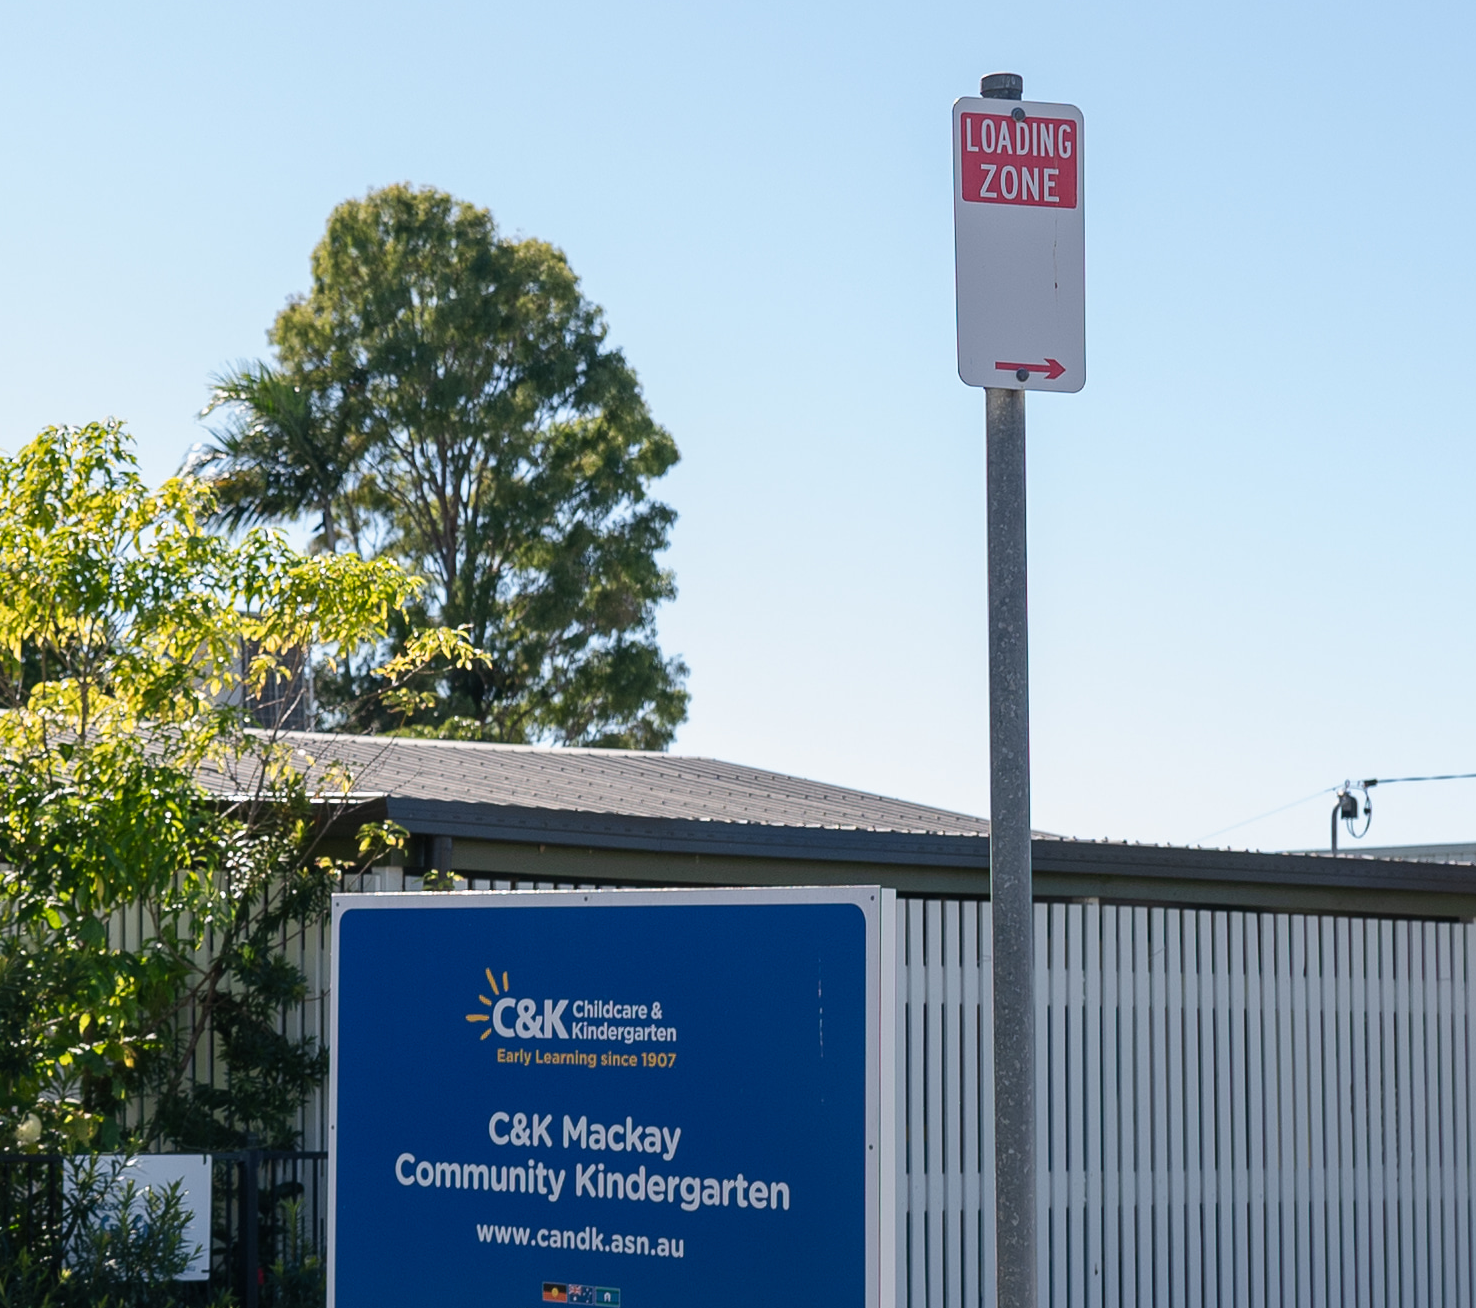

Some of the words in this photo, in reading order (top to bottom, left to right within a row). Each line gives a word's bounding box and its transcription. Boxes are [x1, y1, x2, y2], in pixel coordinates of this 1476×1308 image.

[966, 118, 1072, 159] LOADING
[980, 164, 1060, 203] ZONE
[493, 998, 569, 1039] C&K
[573, 1000, 647, 1019] Childcare
[651, 1002, 662, 1019] &
[572, 1022, 676, 1044] Kindergarten
[497, 1048, 531, 1066] Early
[536, 1050, 596, 1068] Learning
[601, 1051, 637, 1066] since
[641, 1053, 676, 1067] 1907
[489, 1112, 552, 1147] C&K
[563, 1115, 681, 1161] Mackay
[395, 1153, 565, 1202] Community
[576, 1163, 789, 1211] Kindergarten
[477, 1224, 683, 1257] www.candk.asn.au
